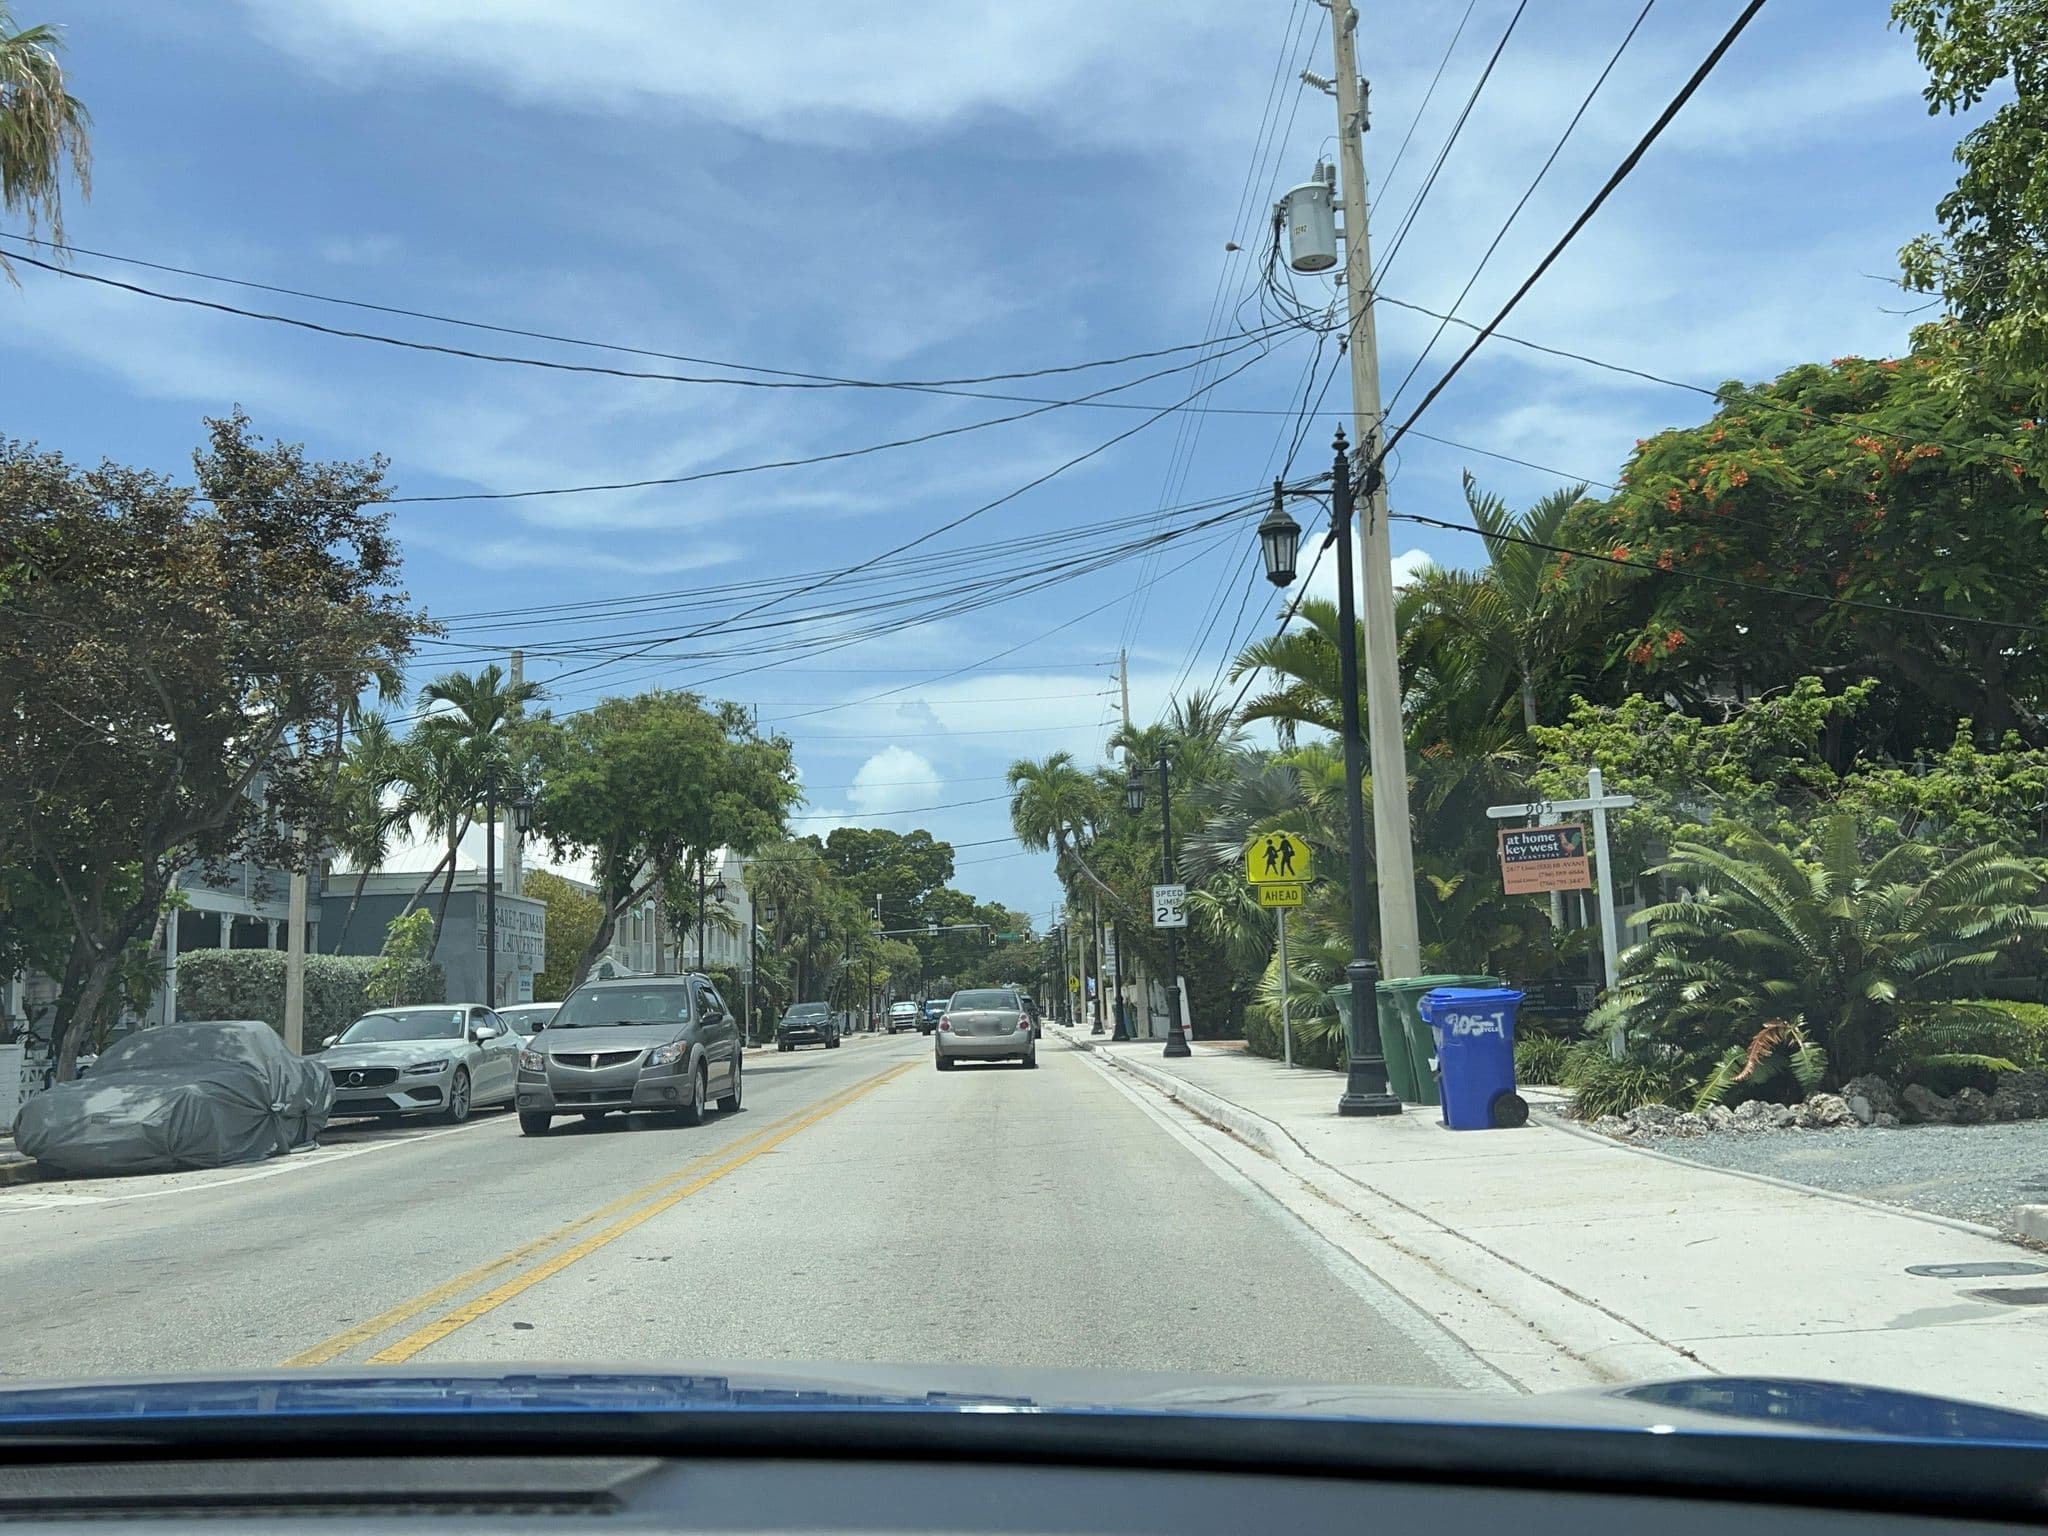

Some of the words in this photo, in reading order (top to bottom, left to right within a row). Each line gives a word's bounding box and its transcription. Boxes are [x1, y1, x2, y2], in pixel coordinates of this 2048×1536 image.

[1526, 804, 1552, 816] 905
[1506, 836, 1520, 845] at
[1522, 833, 1556, 844] home
[1505, 845, 1528, 856] key
[1530, 842, 1559, 853] west
[1265, 890, 1298, 901] AHEAD
[1157, 907, 1183, 922] 25
